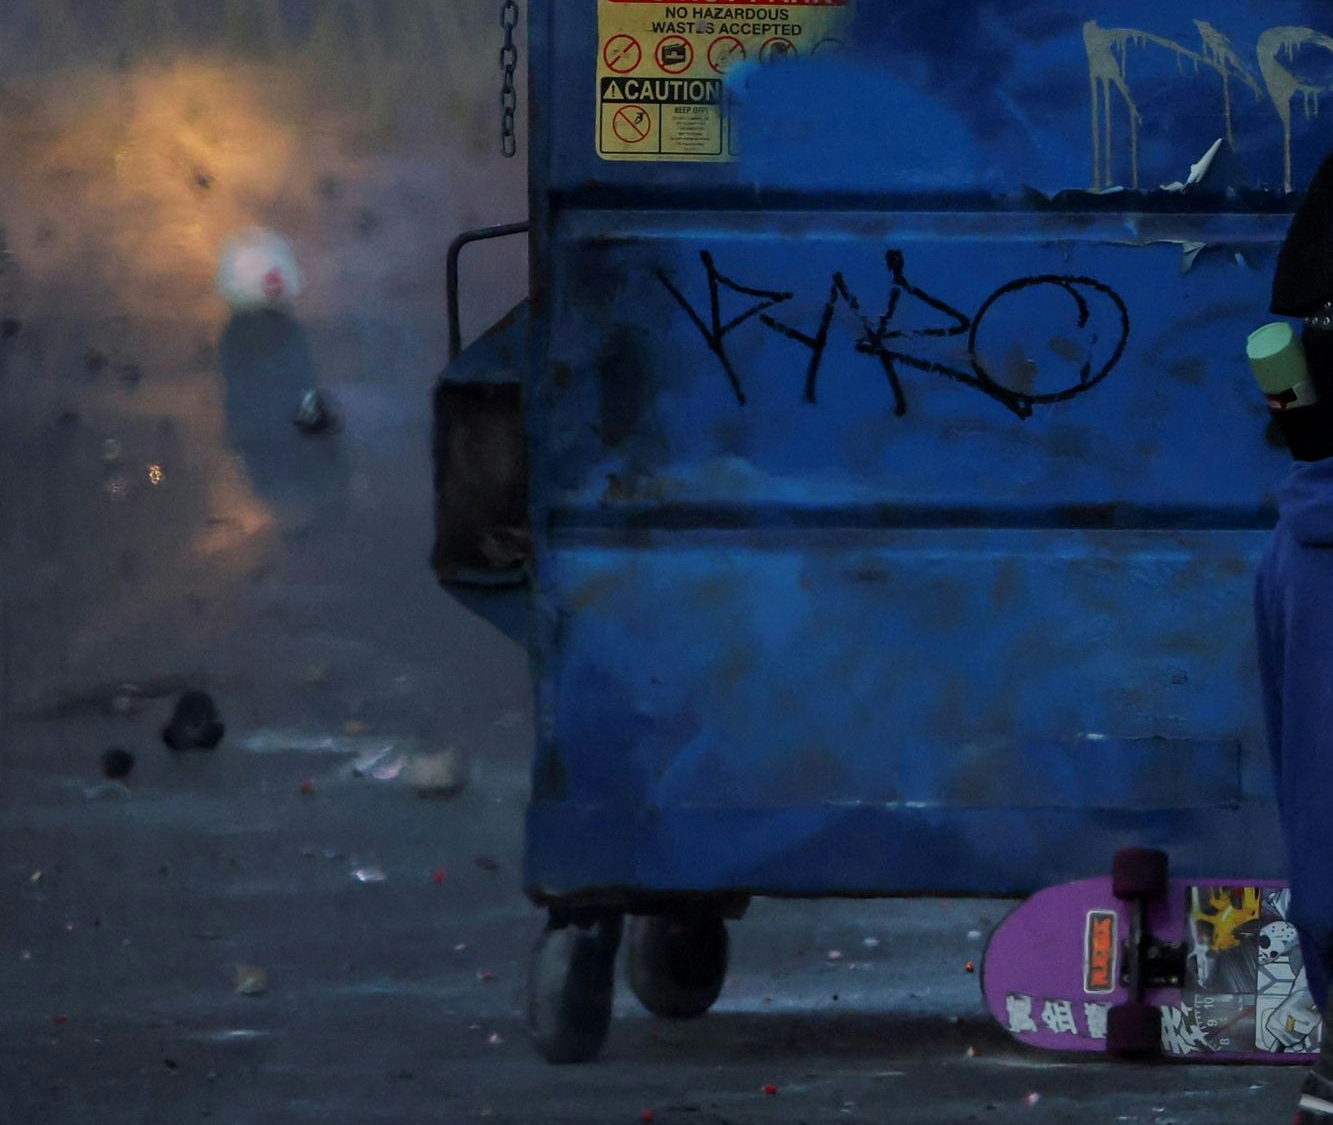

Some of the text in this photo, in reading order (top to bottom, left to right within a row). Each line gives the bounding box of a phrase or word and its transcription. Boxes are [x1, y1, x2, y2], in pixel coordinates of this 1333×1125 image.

[665, 6, 789, 21] NO HAZARDOUS
[652, 21, 802, 36] WASTS ACCEPTED
[624, 79, 721, 102] CAUTION
